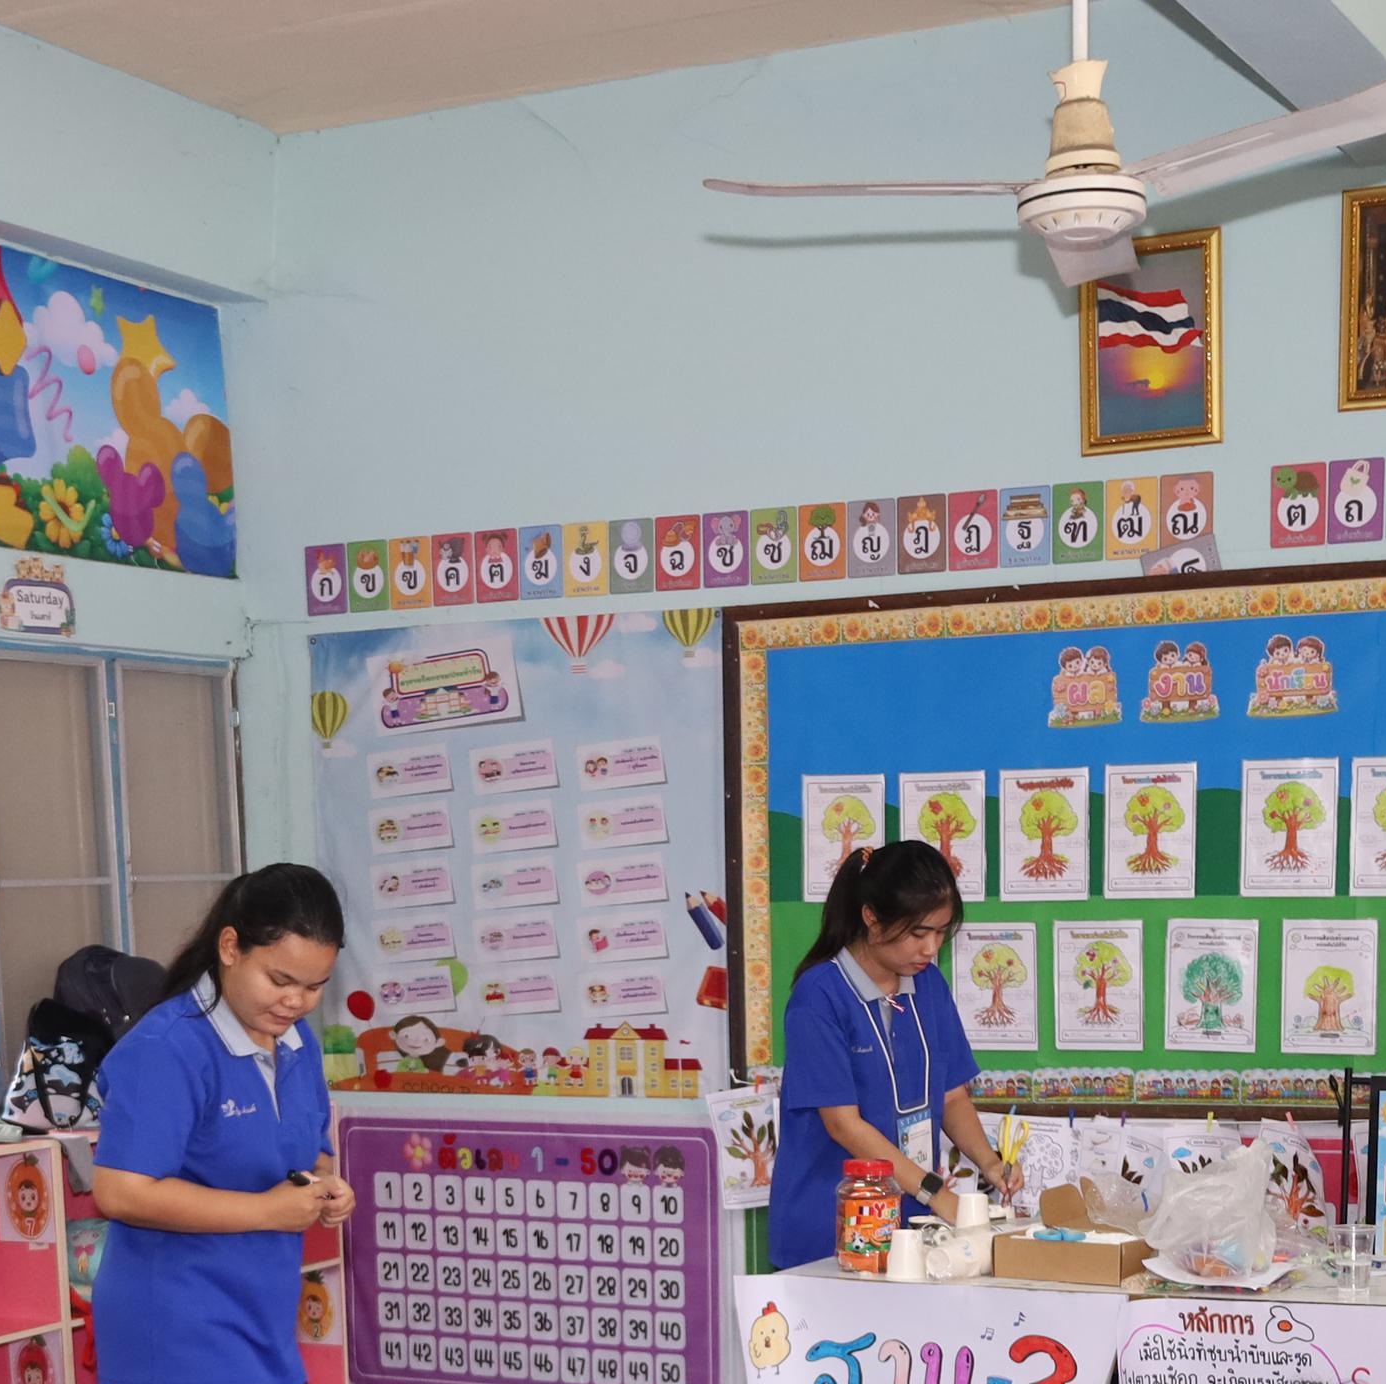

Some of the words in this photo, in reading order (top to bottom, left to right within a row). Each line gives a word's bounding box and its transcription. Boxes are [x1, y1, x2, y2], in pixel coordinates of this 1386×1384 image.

[1286, 507, 1306, 528] ต
[1344, 502, 1363, 522] ถ
[319, 575, 333, 595] ก
[579, 558, 591, 577] ง
[624, 551, 638, 573] จ
[669, 550, 685, 570] ฉ
[810, 537, 833, 561] ฌ
[862, 534, 882, 562] ญ
[1018, 520, 1031, 549] ฐ
[1117, 515, 1142, 539] ฒ
[1172, 511, 1199, 535] ณ
[16, 590, 64, 610] Saturday
[1066, 681, 1106, 706] ผล
[1154, 671, 1207, 697] งาน
[1266, 667, 1327, 692] นักเรียน
[437, 1132, 522, 1173] ตัวเลข
[580, 1147, 619, 1178] 50
[385, 1181, 392, 1200] 1
[413, 1182, 423, 1202] 2
[445, 1185, 455, 1205] 3
[475, 1187, 485, 1205] 4
[505, 1187, 514, 1207] 5
[536, 1189, 545, 1209] 6
[569, 1191, 578, 1210] 7
[600, 1193, 610, 1212] 8
[632, 1195, 641, 1214] 9
[661, 1195, 677, 1215] 10
[383, 1221, 396, 1239] 11
[411, 1222, 426, 1242] 12
[443, 1226, 458, 1246] 13
[472, 1227, 488, 1246] 14
[502, 1228, 518, 1248] 15
[533, 1230, 548, 1250] 16
[566, 1233, 581, 1252] 17
[597, 1234, 614, 1254] 18
[629, 1236, 644, 1256] 19
[659, 1237, 680, 1257] 20
[383, 1261, 399, 1281] 21
[411, 1262, 429, 1283] 22
[442, 1266, 461, 1287] 23
[472, 1267, 491, 1288] 24
[502, 1270, 520, 1289] 25
[533, 1271, 551, 1291] 26
[565, 1275, 583, 1295] 27
[597, 1276, 616, 1296] 28
[628, 1278, 647, 1298] 29
[660, 1280, 679, 1300] 30
[384, 1301, 400, 1321] 31
[413, 1302, 430, 1323] 32
[444, 1306, 462, 1327] 33
[474, 1308, 492, 1328] 34
[503, 1310, 521, 1330] 35
[534, 1312, 552, 1332] 36
[566, 1316, 584, 1336] 37
[598, 1317, 617, 1338] 38
[629, 1319, 647, 1340] 39
[660, 1322, 681, 1341] 40
[1179, 1305, 1255, 1336] หลักการ
[385, 1341, 401, 1360] 41
[413, 1343, 432, 1363] 42
[445, 1347, 464, 1367] 43
[474, 1349, 494, 1368] 44
[503, 1351, 522, 1370] 45
[534, 1353, 553, 1373] 46
[567, 1357, 585, 1377] 47
[598, 1359, 618, 1379] 48
[629, 1362, 648, 1382] 49
[661, 1363, 680, 1383] 50
